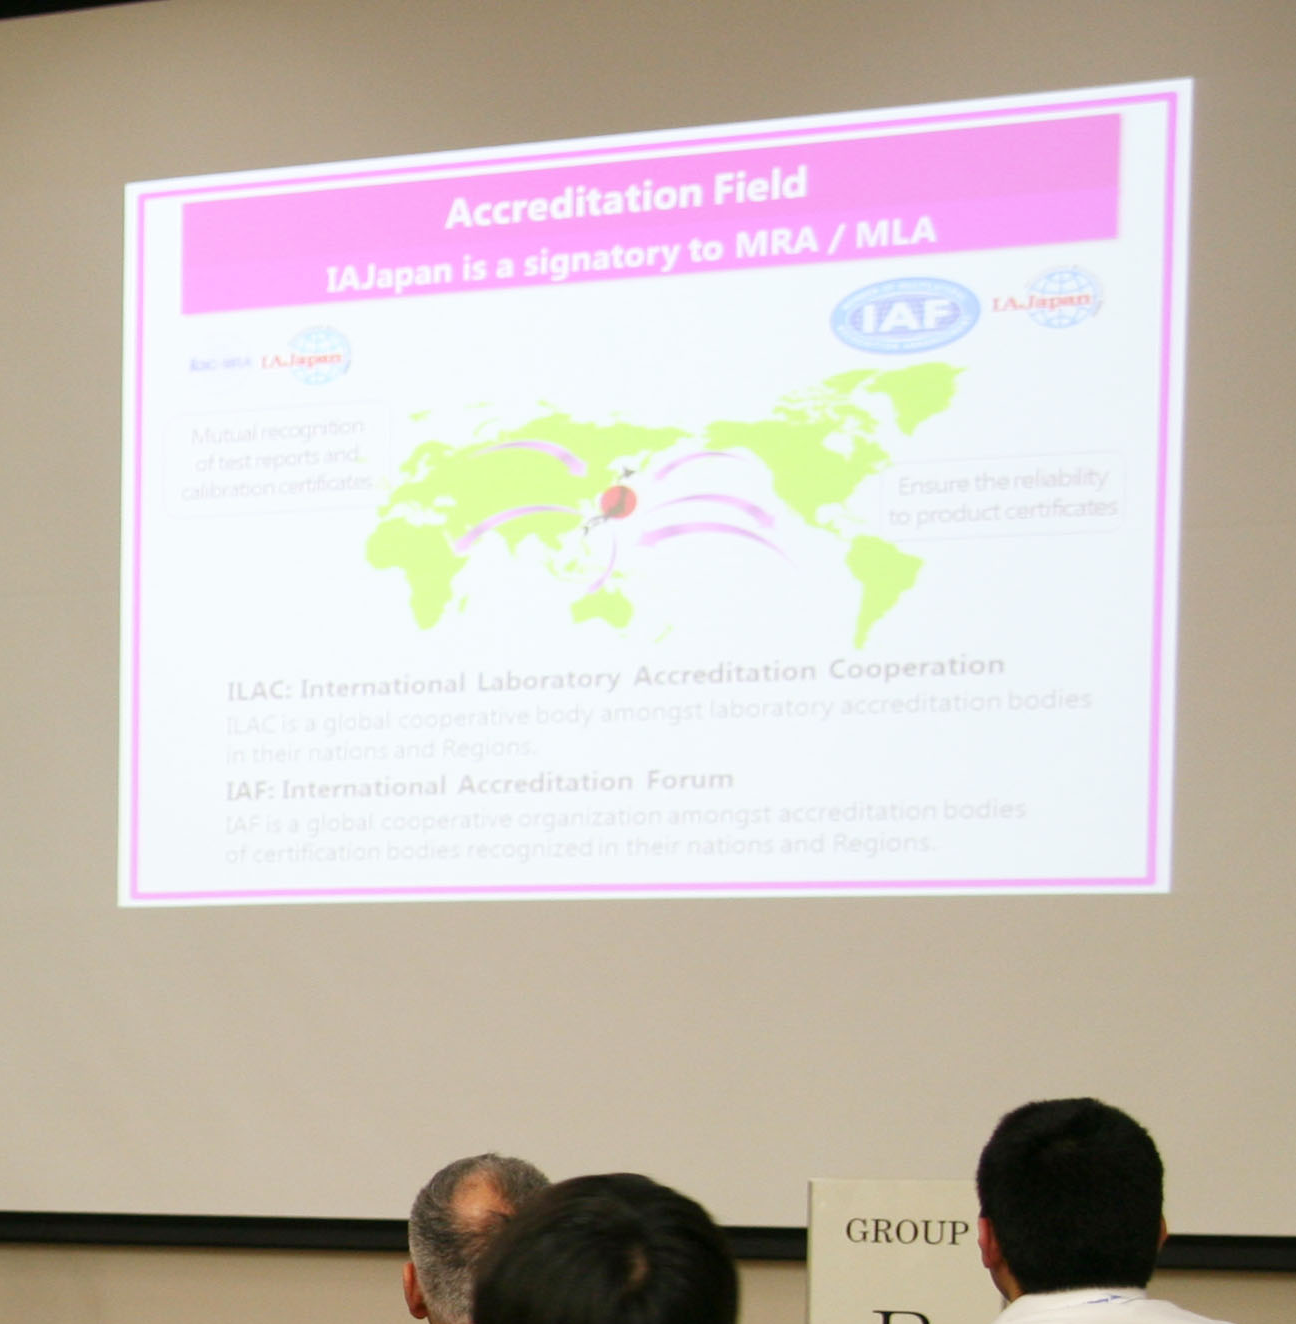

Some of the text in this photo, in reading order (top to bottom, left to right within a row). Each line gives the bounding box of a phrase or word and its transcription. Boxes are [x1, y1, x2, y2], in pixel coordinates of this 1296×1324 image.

[445, 166, 808, 230] Accreditation Field
[327, 216, 937, 295] IAJapan is a signatory to MRA / MLA
[862, 299, 951, 334] IAF
[192, 419, 366, 445] Mutual recognition
[195, 445, 359, 472] of test reports and
[181, 474, 373, 501] calibration certificates
[899, 466, 1110, 496] Ensure the reliability
[889, 497, 1118, 529] to product certificates
[227, 654, 1005, 701] ILAC: International Laboratory Accreditation Cooperation
[227, 688, 1093, 738] ILAC is a global cooperative body amongst laboratory accreditation bodies
[226, 737, 537, 764] in their nations and Regions.
[226, 768, 734, 801] IAF: International Accreditation Forum
[226, 798, 1027, 839] IAF is a global cooperative organization amongst accreditation bodies
[225, 831, 936, 863] of certification bodies recognized in their nations and Regions.
[846, 1217, 969, 1246] GROUP
